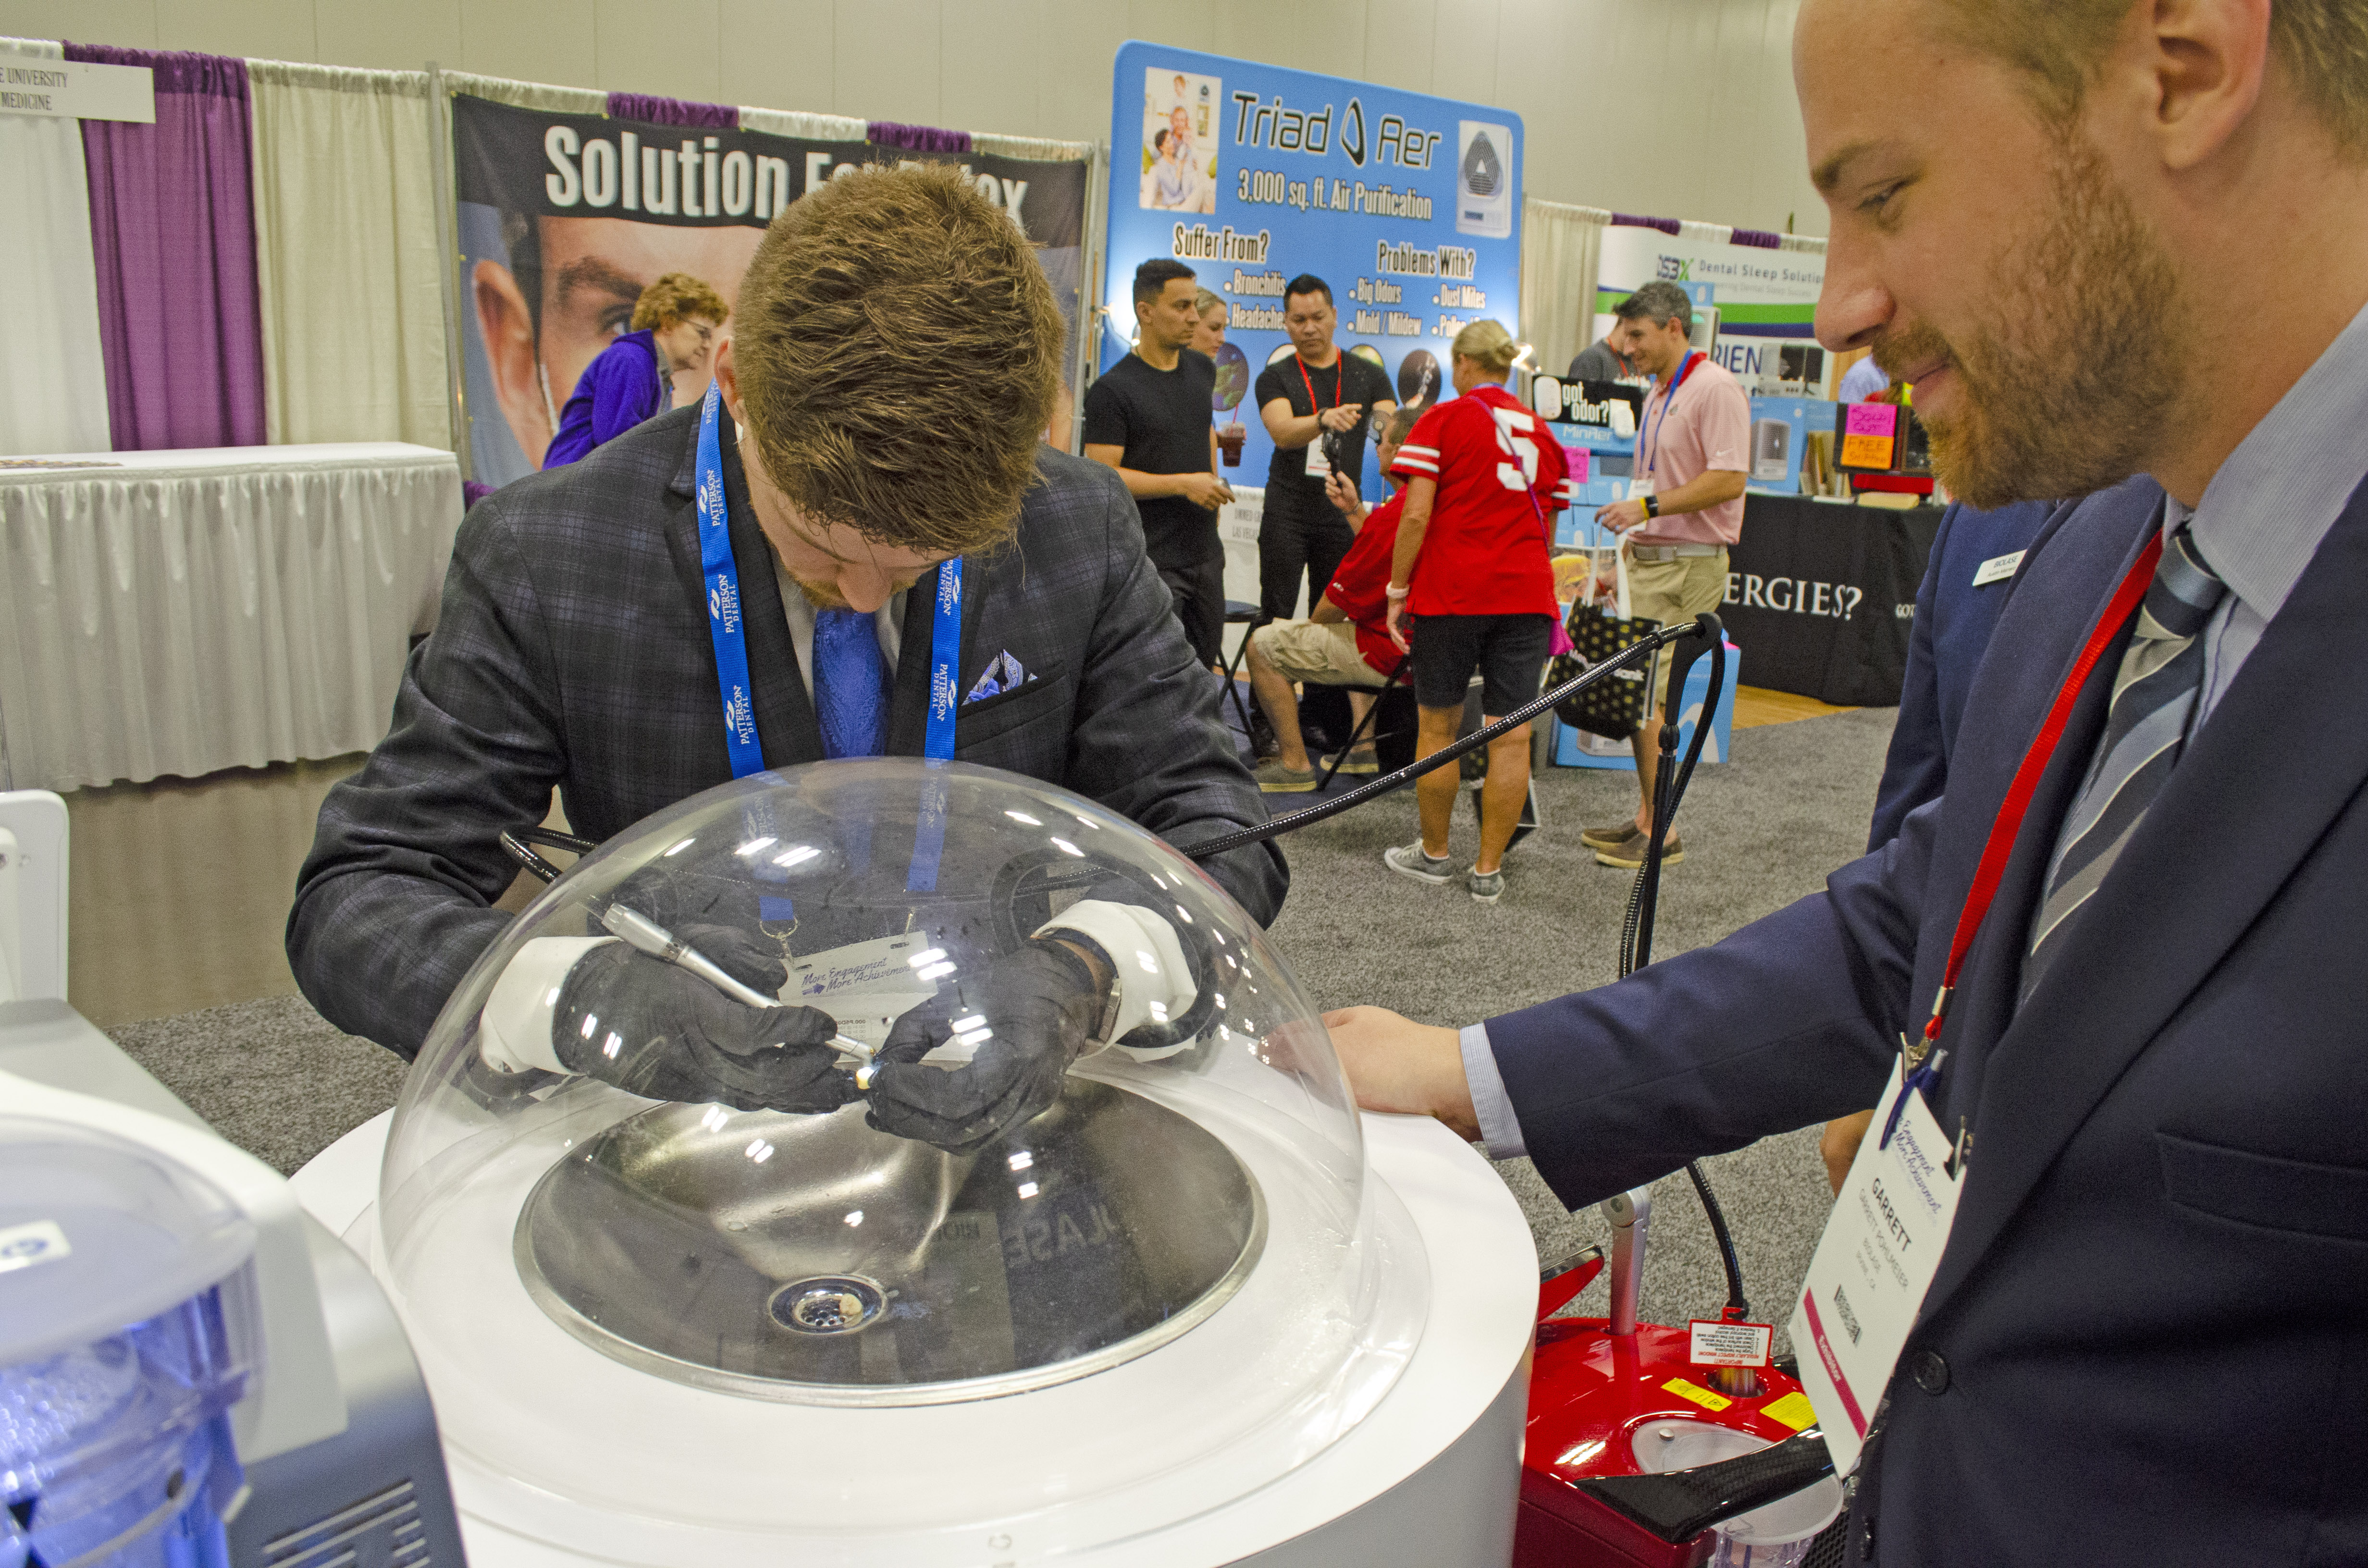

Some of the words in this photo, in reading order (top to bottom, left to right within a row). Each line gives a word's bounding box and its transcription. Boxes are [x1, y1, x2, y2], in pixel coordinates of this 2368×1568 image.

[7, 68, 68, 88] UNIVERSITY
[1, 92, 52, 110] MEDICINE
[1233, 90, 1333, 155] Triad
[1377, 115, 1442, 170] Aer
[545, 125, 790, 220] Solution
[1238, 168, 1285, 204] 3,000
[1288, 181, 1310, 212] sq.
[1313, 177, 1327, 209] ft.
[1330, 179, 1351, 212] Air
[1354, 181, 1432, 221] Purification
[1174, 222, 1221, 260] Suffer
[1222, 226, 1270, 264] From?
[1377, 240, 1437, 276] Problems
[1438, 245, 1476, 280] With?
[1233, 269, 1286, 297] Bronchitis
[1700, 259, 1738, 276] Dental
[1742, 263, 1777, 281] Sleep
[1357, 277, 1374, 306] Big
[1375, 279, 1402, 305] Odors
[1441, 283, 1461, 308] Dust
[1462, 285, 1486, 309] Mites
[1232, 303, 1288, 330] Headache
[1356, 309, 1381, 334] Mold
[1388, 311, 1422, 336] Mildew
[1562, 381, 1584, 407] got
[1571, 398, 1609, 424] odor?
[1492, 407, 1539, 491] 5
[707, 469, 721, 527] PATTERSON
[715, 478, 725, 514] DENTAL
[938, 566, 947, 602] DENTAL
[943, 560, 953, 616] PATTERSON
[718, 574, 735, 633] PATTERSON
[729, 584, 739, 622] DENTAL
[937, 663, 949, 721] PATTERSON
[733, 685, 750, 745] PATTERSON
[742, 696, 754, 733] DENTAL
[802, 973, 826, 986] More
[829, 957, 888, 979] Engagement
[826, 978, 852, 992] More
[1872, 1177, 1912, 1251] GARRETT
